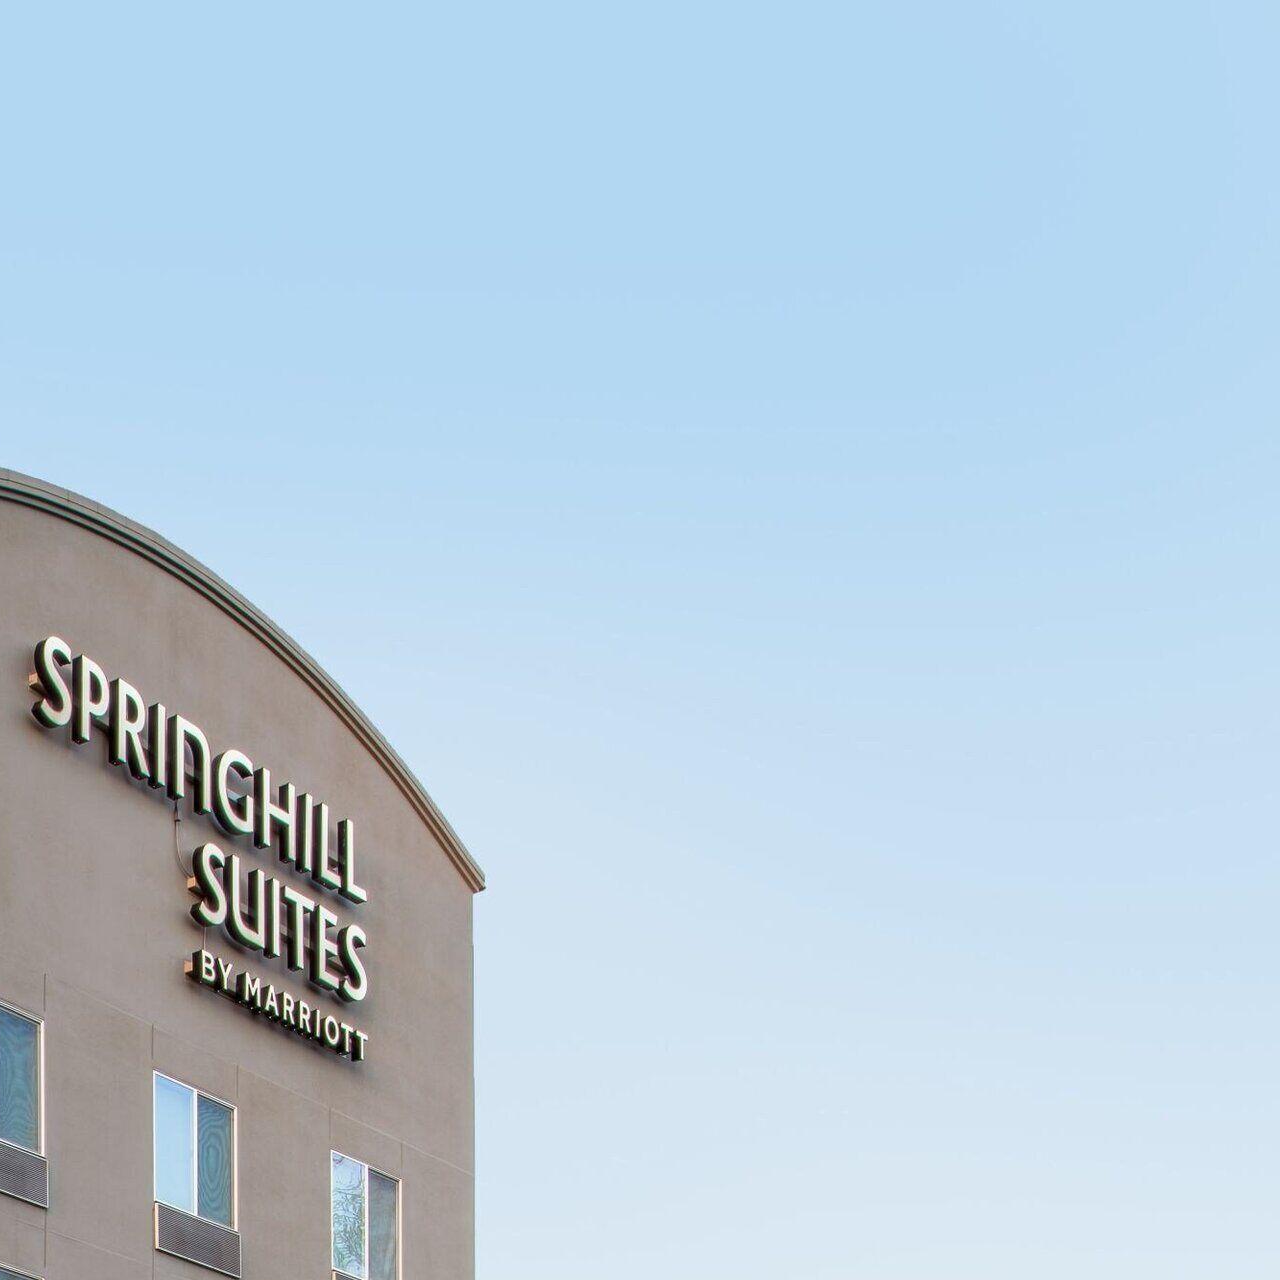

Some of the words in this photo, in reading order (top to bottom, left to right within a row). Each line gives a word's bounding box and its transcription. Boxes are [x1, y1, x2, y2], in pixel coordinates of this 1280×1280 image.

[31, 636, 367, 904] SPRINGHILL
[190, 842, 368, 1002] SUITES
[192, 949, 233, 993] BY
[237, 971, 368, 1062] MARRIOTT
